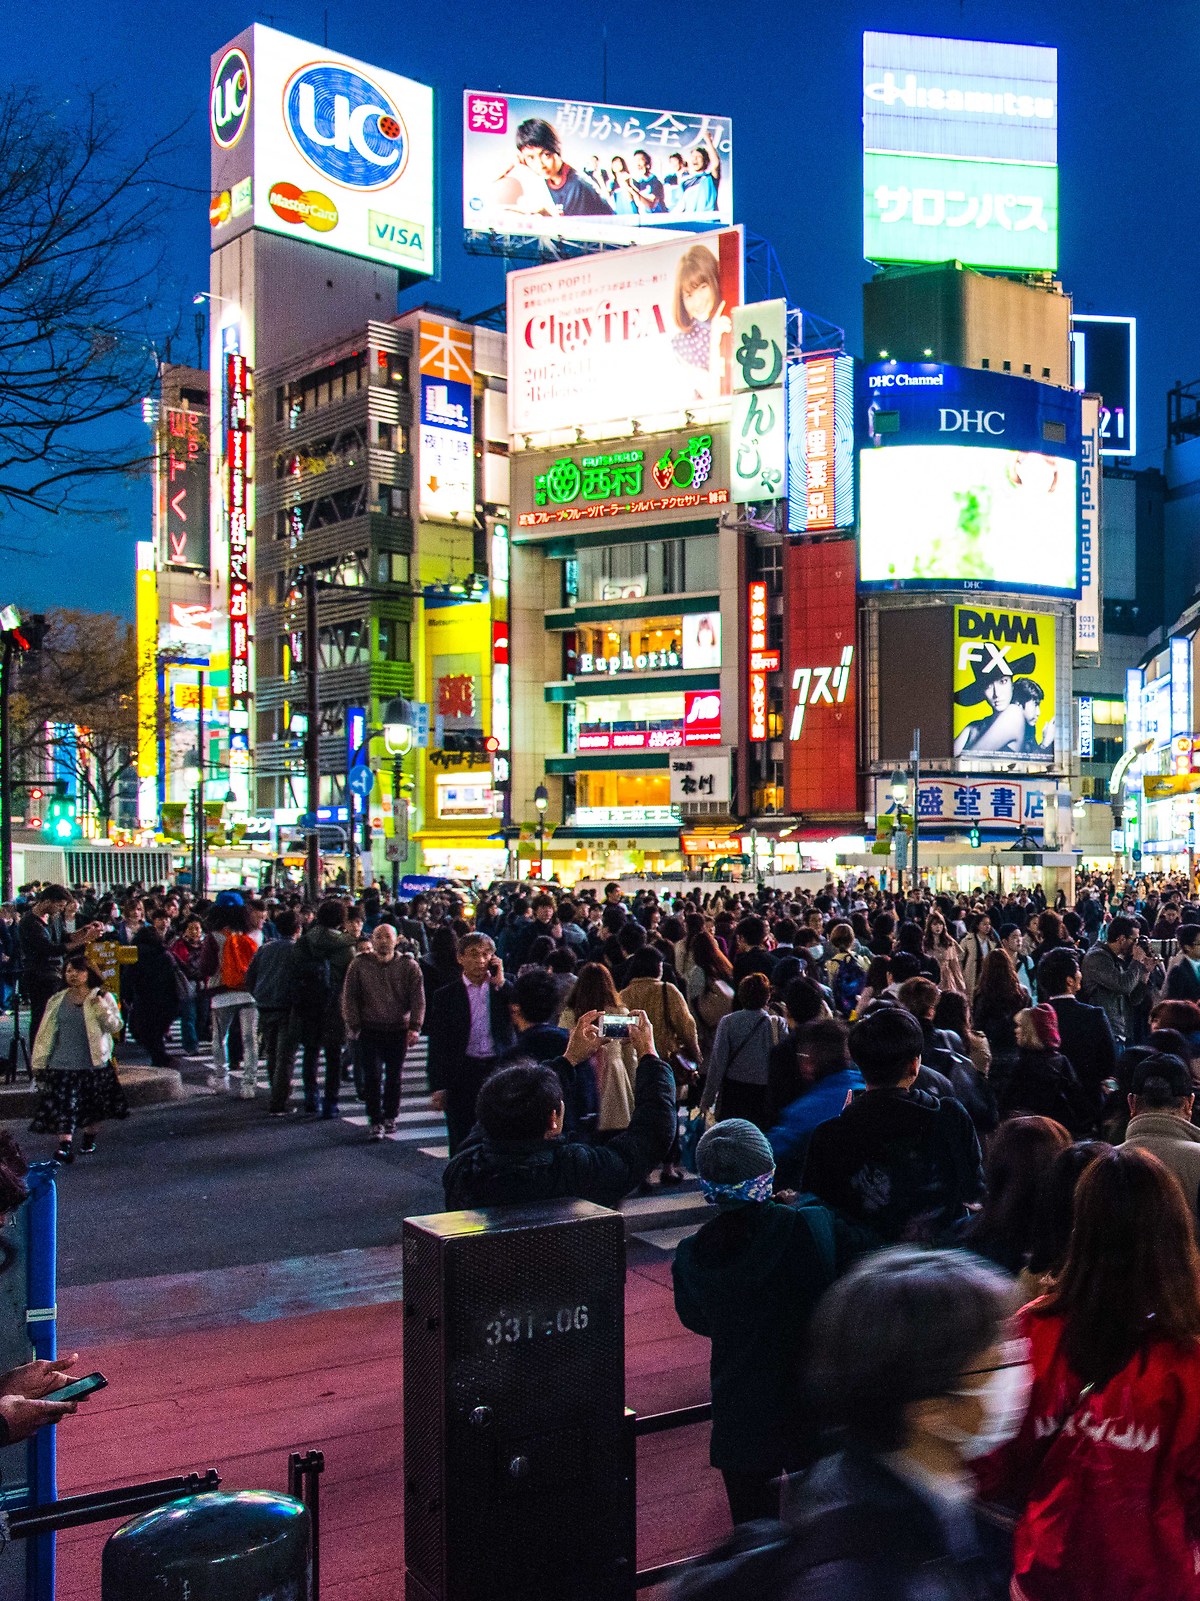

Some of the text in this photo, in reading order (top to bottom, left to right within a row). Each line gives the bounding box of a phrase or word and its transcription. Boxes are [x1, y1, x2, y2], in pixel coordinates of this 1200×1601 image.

[471, 98, 503, 114] あさ
[472, 115, 505, 131] チャン
[270, 193, 338, 222] MasterCard
[873, 185, 1048, 233] サロンパス
[376, 223, 423, 250] VISA
[420, 325, 472, 381] 本
[869, 373, 944, 387] DHC Channel
[736, 324, 783, 494] もんじゃ
[938, 408, 1006, 435] DHC
[963, 581, 983, 590] DHC
[958, 609, 1040, 646] DMM
[580, 648, 679, 675] Euphoria
[958, 642, 1014, 676] FX
